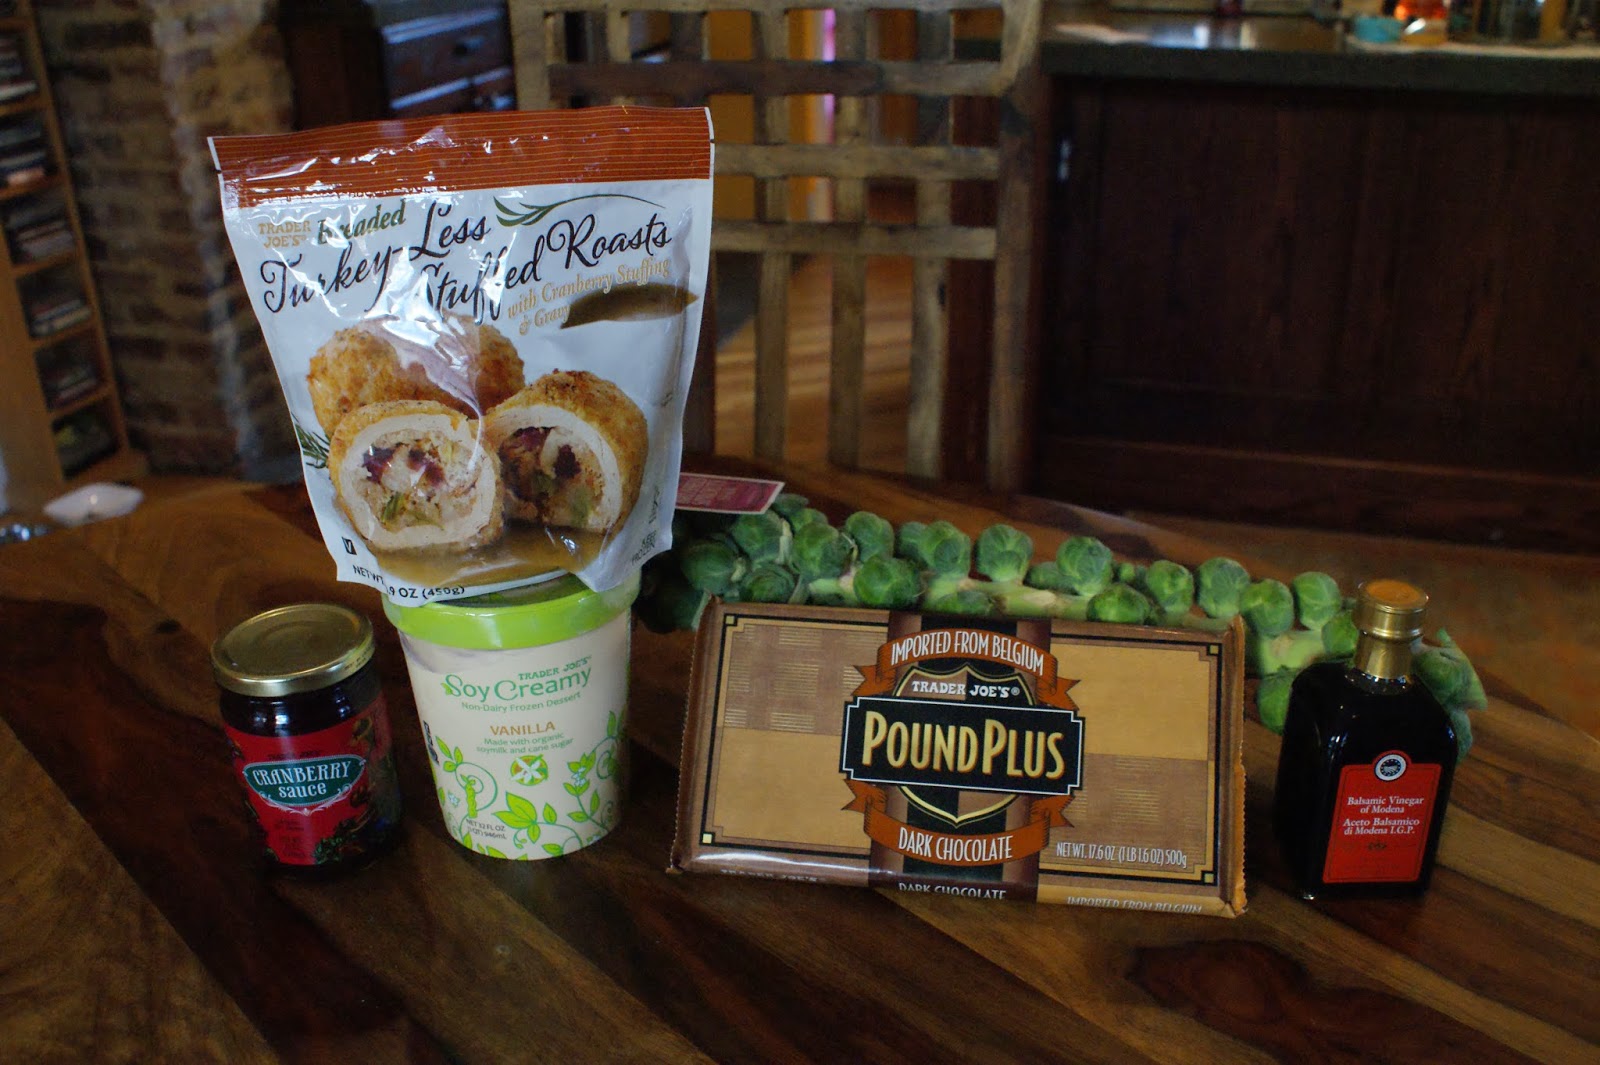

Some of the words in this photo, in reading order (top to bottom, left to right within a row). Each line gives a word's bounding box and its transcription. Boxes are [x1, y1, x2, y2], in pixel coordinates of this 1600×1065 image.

[258, 221, 312, 235] TRADER
[318, 198, 406, 245] Beaded
[546, 213, 672, 269] Roasts
[508, 289, 537, 319] with
[541, 273, 613, 303] Cranberry
[616, 257, 670, 287] Stuffing
[519, 315, 531, 335] &
[534, 305, 571, 327] Gravy
[353, 564, 370, 577] NET
[398, 587, 419, 599] OZ
[422, 585, 465, 600] (450g)
[891, 631, 951, 666] IMPORTED
[954, 631, 989, 656] FROM
[992, 634, 1044, 676] BELGIUM
[445, 674, 490, 703] Soy
[494, 667, 592, 701] Creamy
[518, 667, 559, 681] TRADER
[911, 681, 966, 695] TRADER
[461, 701, 507, 714] Non-Dairy
[510, 702, 544, 712] Frozen
[546, 691, 581, 708] Dessert
[484, 738, 508, 746] Made
[510, 736, 530, 745] with
[531, 733, 564, 746] organic
[490, 721, 556, 736] VANILLA
[476, 746, 507, 755] soymilk
[509, 745, 526, 754] and
[528, 744, 549, 752] cane
[551, 738, 574, 749] sugar
[862, 710, 979, 772] POUND
[982, 719, 1065, 779] PLUS
[252, 761, 351, 786] CRANBERRY
[278, 782, 327, 799] sauce
[1347, 796, 1386, 806] Balsamic
[1388, 795, 1424, 807] Vinegar
[1360, 805, 1369, 814] of
[1371, 805, 1404, 814] Modena
[1342, 818, 1370, 827] Aceto
[1373, 817, 1420, 826] Balsamico
[1344, 826, 1353, 835] di
[1355, 826, 1388, 835] Modena
[1390, 826, 1415, 834] I.G.P.
[898, 827, 933, 858] DARK
[935, 835, 1014, 862] CHOCOLATE
[1056, 842, 1071, 858] NET
[1088, 844, 1103, 860] 17.6
[1105, 845, 1115, 861] OZ
[1126, 848, 1137, 862] LB
[1138, 848, 1149, 863] 1.6
[1150, 849, 1164, 866] OZ)
[1165, 849, 1187, 868] 500g
